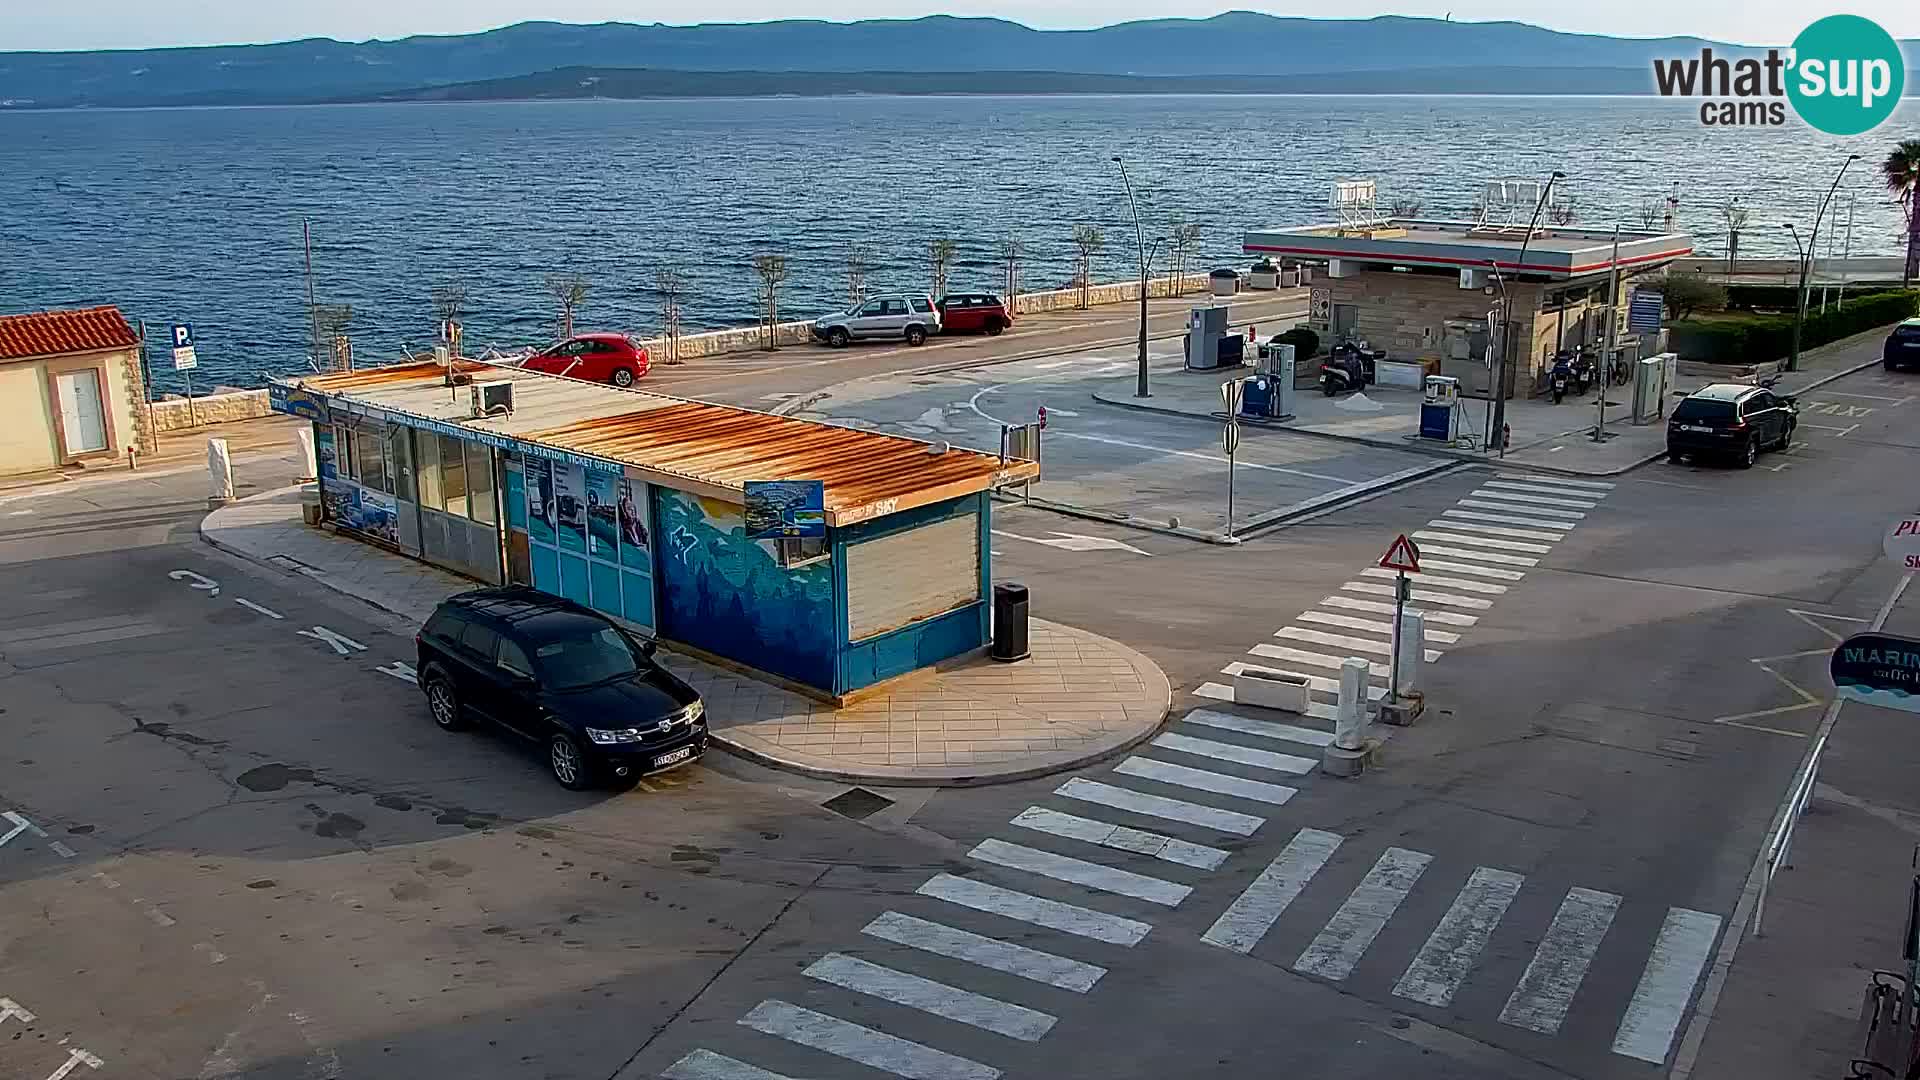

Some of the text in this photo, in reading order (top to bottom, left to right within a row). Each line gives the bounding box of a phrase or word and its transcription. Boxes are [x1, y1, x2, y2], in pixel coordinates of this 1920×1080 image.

[175, 327, 188, 345] P
[518, 443, 620, 474] BUS STATION TICKET OFFICE
[1894, 520, 1920, 536] PI
